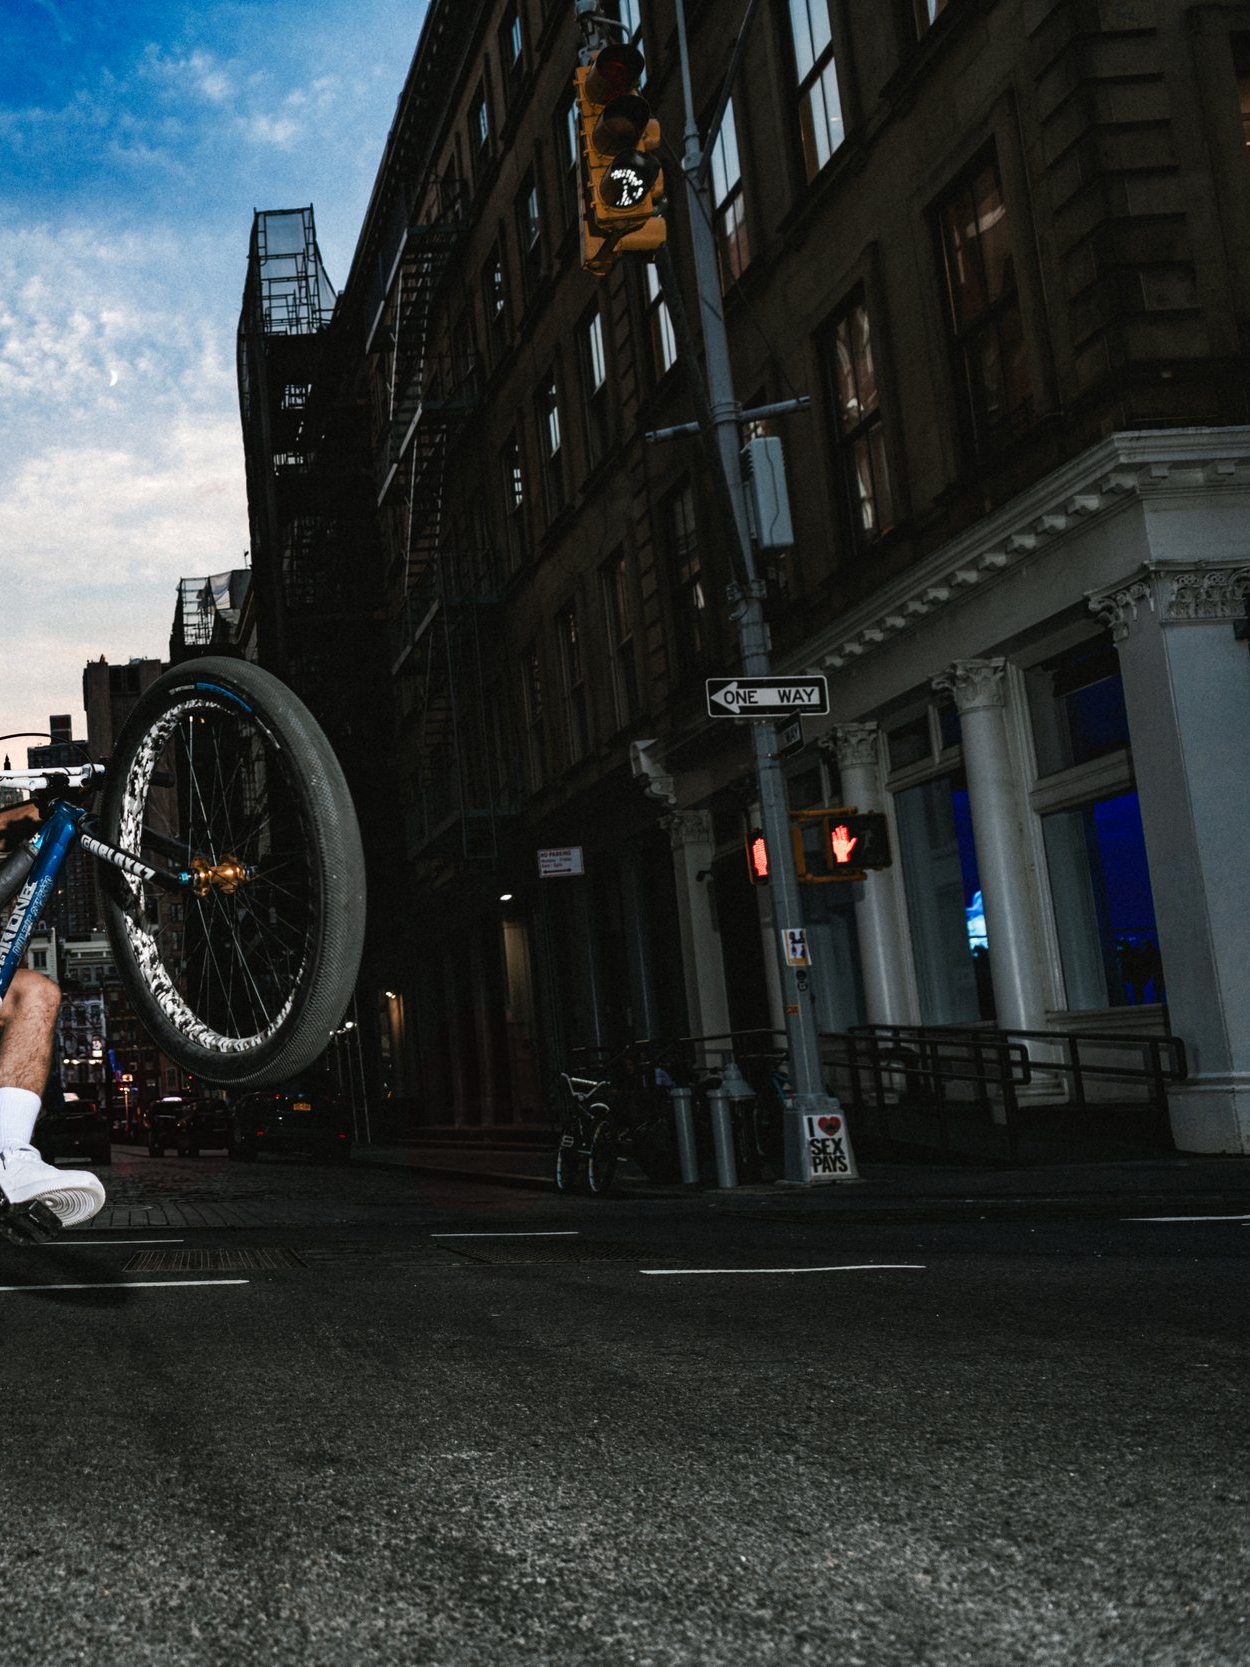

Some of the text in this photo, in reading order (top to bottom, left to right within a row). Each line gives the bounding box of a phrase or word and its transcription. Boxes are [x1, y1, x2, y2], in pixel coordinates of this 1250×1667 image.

[724, 688, 815, 704] ONE WAY
[807, 1116, 815, 1138] I
[810, 1137, 845, 1156] SEX
[812, 1155, 848, 1173] PAYS
